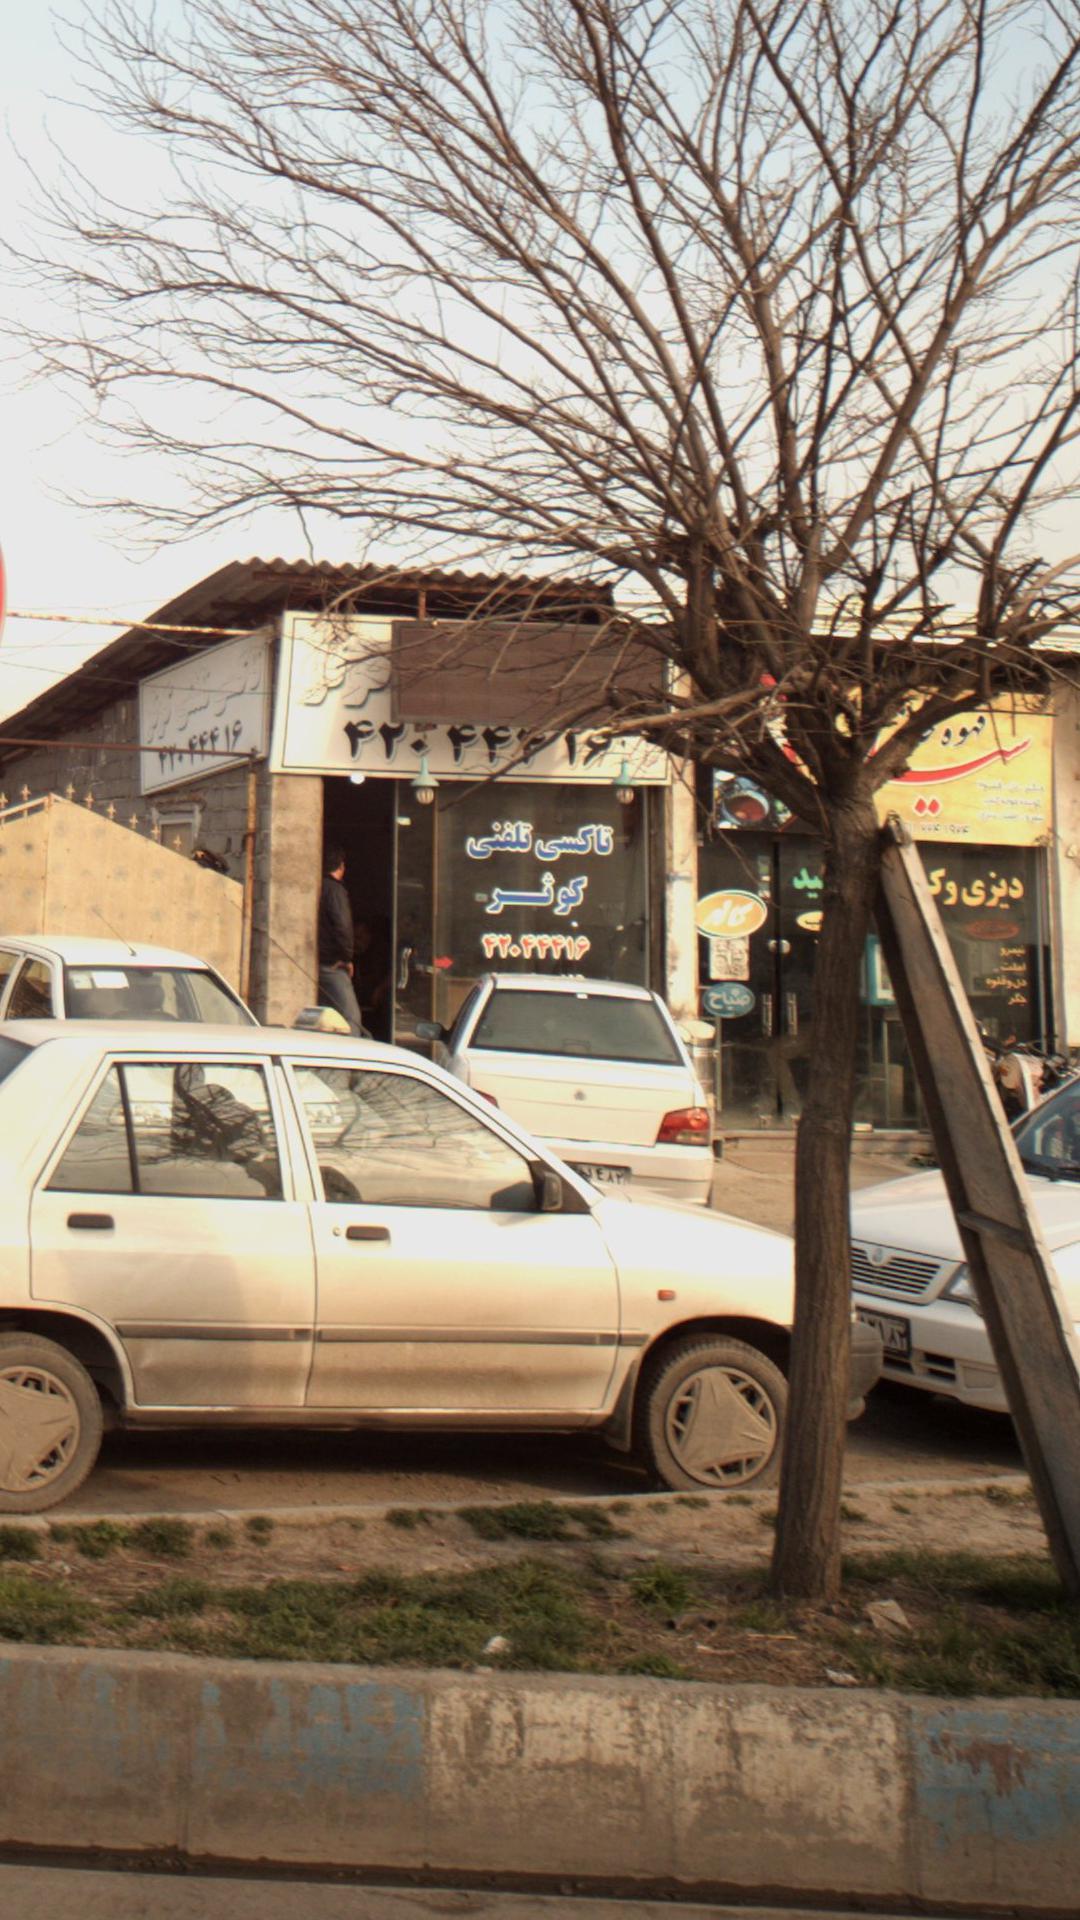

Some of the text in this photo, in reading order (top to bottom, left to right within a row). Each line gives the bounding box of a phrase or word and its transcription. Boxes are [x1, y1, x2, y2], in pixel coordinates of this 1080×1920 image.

[465, 821, 614, 861] تاکسی تلفنی
[485, 871, 589, 916] کوثر
[960, 871, 1025, 910] دیزی
[481, 931, 592, 961] ۴۲۰۴۴۴۱۶
